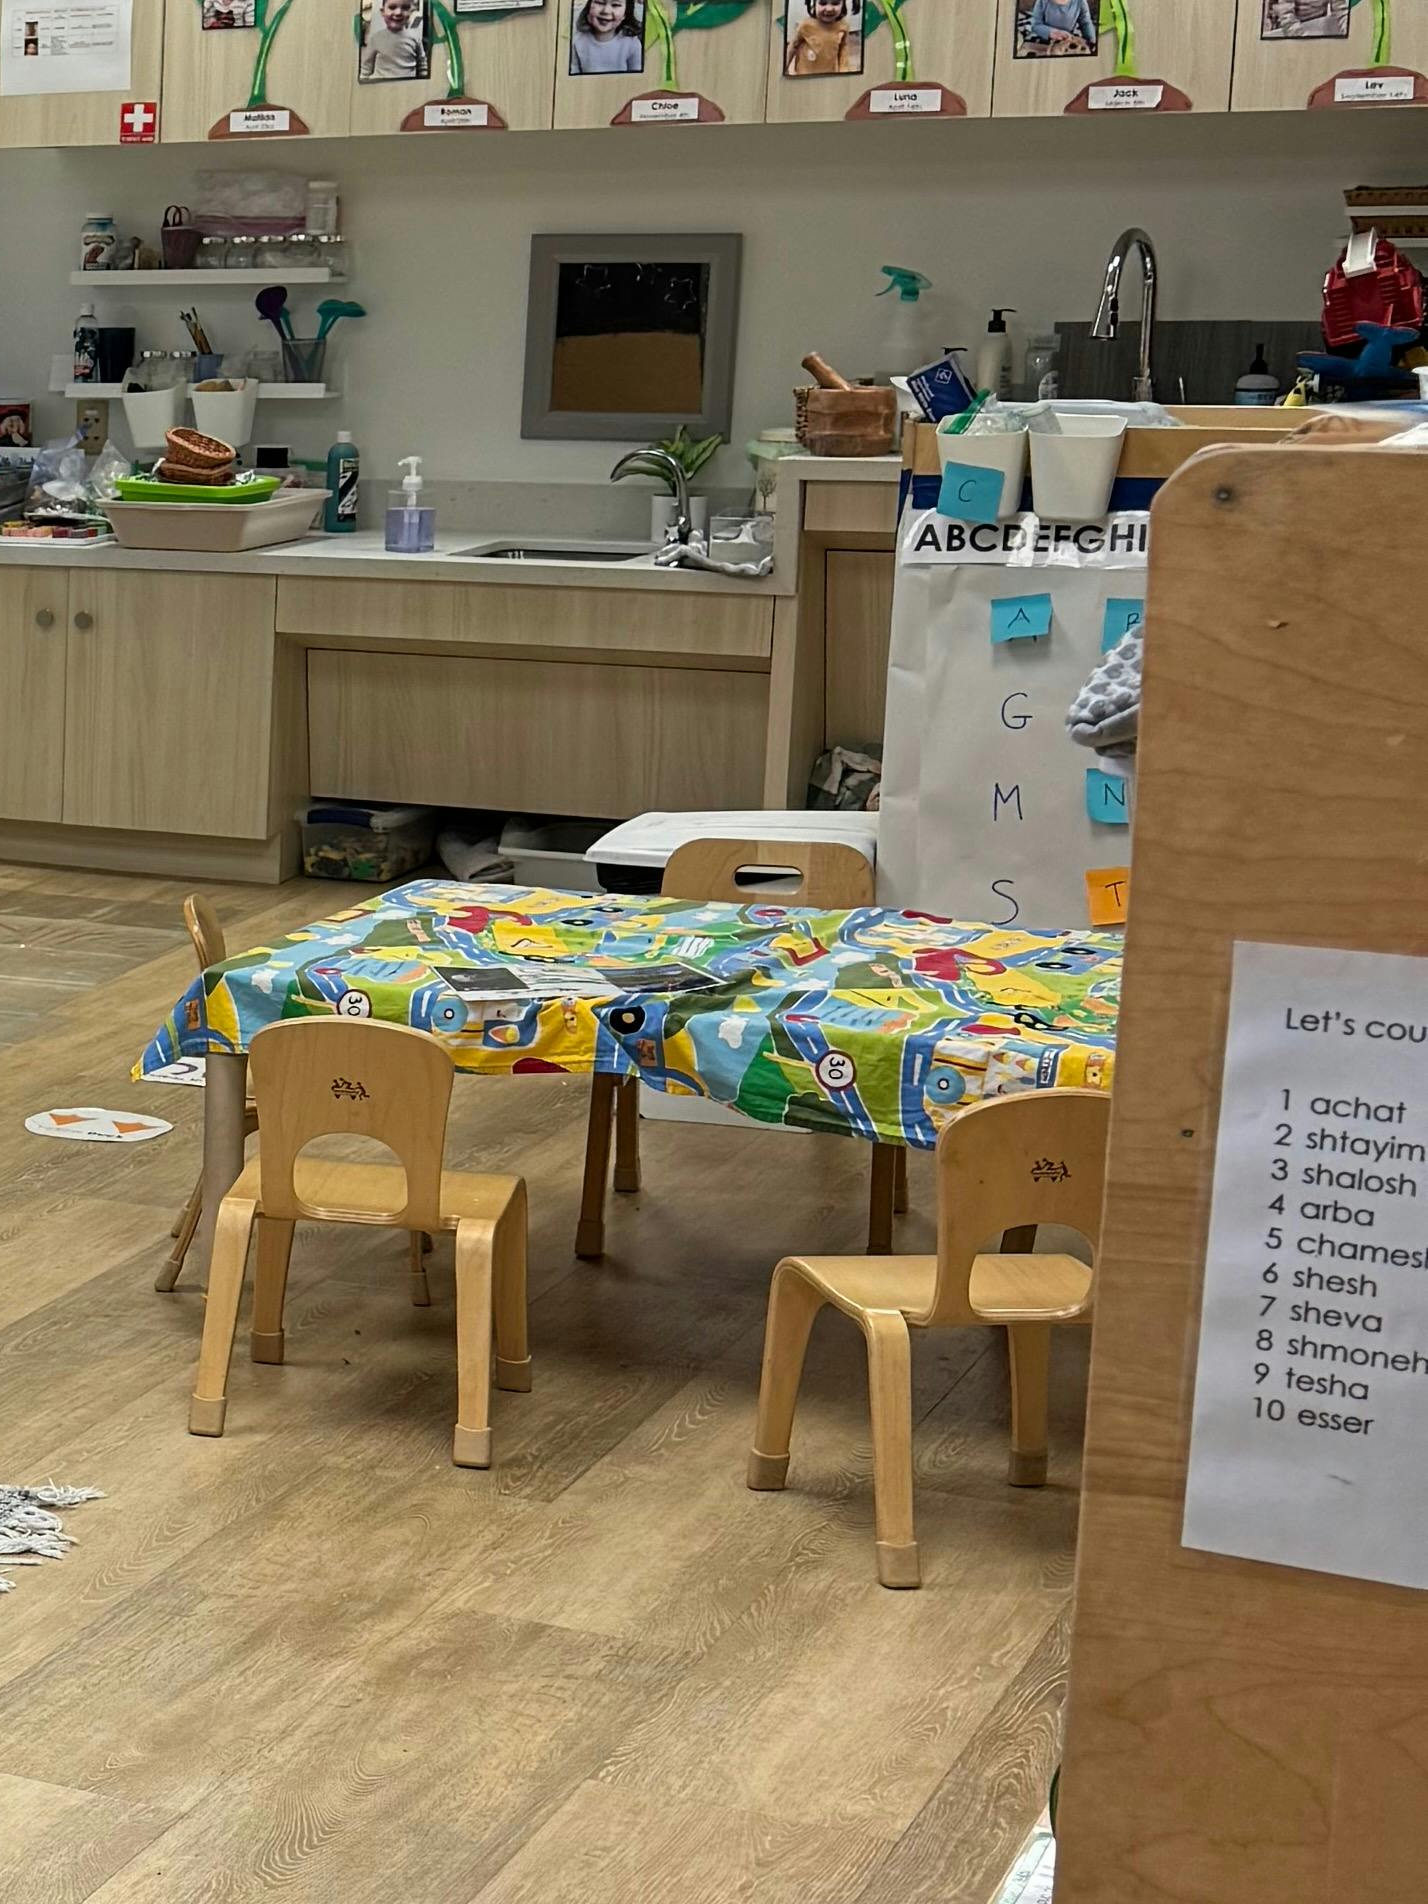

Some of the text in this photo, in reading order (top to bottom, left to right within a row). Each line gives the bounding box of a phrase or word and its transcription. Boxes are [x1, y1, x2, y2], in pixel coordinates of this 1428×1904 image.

[651, 102, 679, 111] Chloe
[958, 480, 978, 504] C
[1007, 607, 1031, 629] A
[1001, 692, 1034, 729] G
[993, 782, 1024, 822] M
[1103, 782, 1126, 807] N
[990, 879, 1020, 926] S
[1104, 880, 1127, 908] T
[1285, 1007, 1428, 1044] Let's cou
[827, 1056, 846, 1080] 30
[1280, 1088, 1407, 1125] 1 achat
[1274, 1123, 1426, 1164] 2 shtayim
[1270, 1159, 1418, 1198] 3 shalosh
[1267, 1194, 1375, 1228] 4 arba
[1265, 1227, 1284, 1251] 5
[1261, 1261, 1378, 1298] 6 shesh
[1258, 1295, 1384, 1334] 7 sheva
[1255, 1328, 1274, 1352] 8
[1253, 1362, 1370, 1401] 9 tesha
[1253, 1397, 1376, 1438] 10 esser
